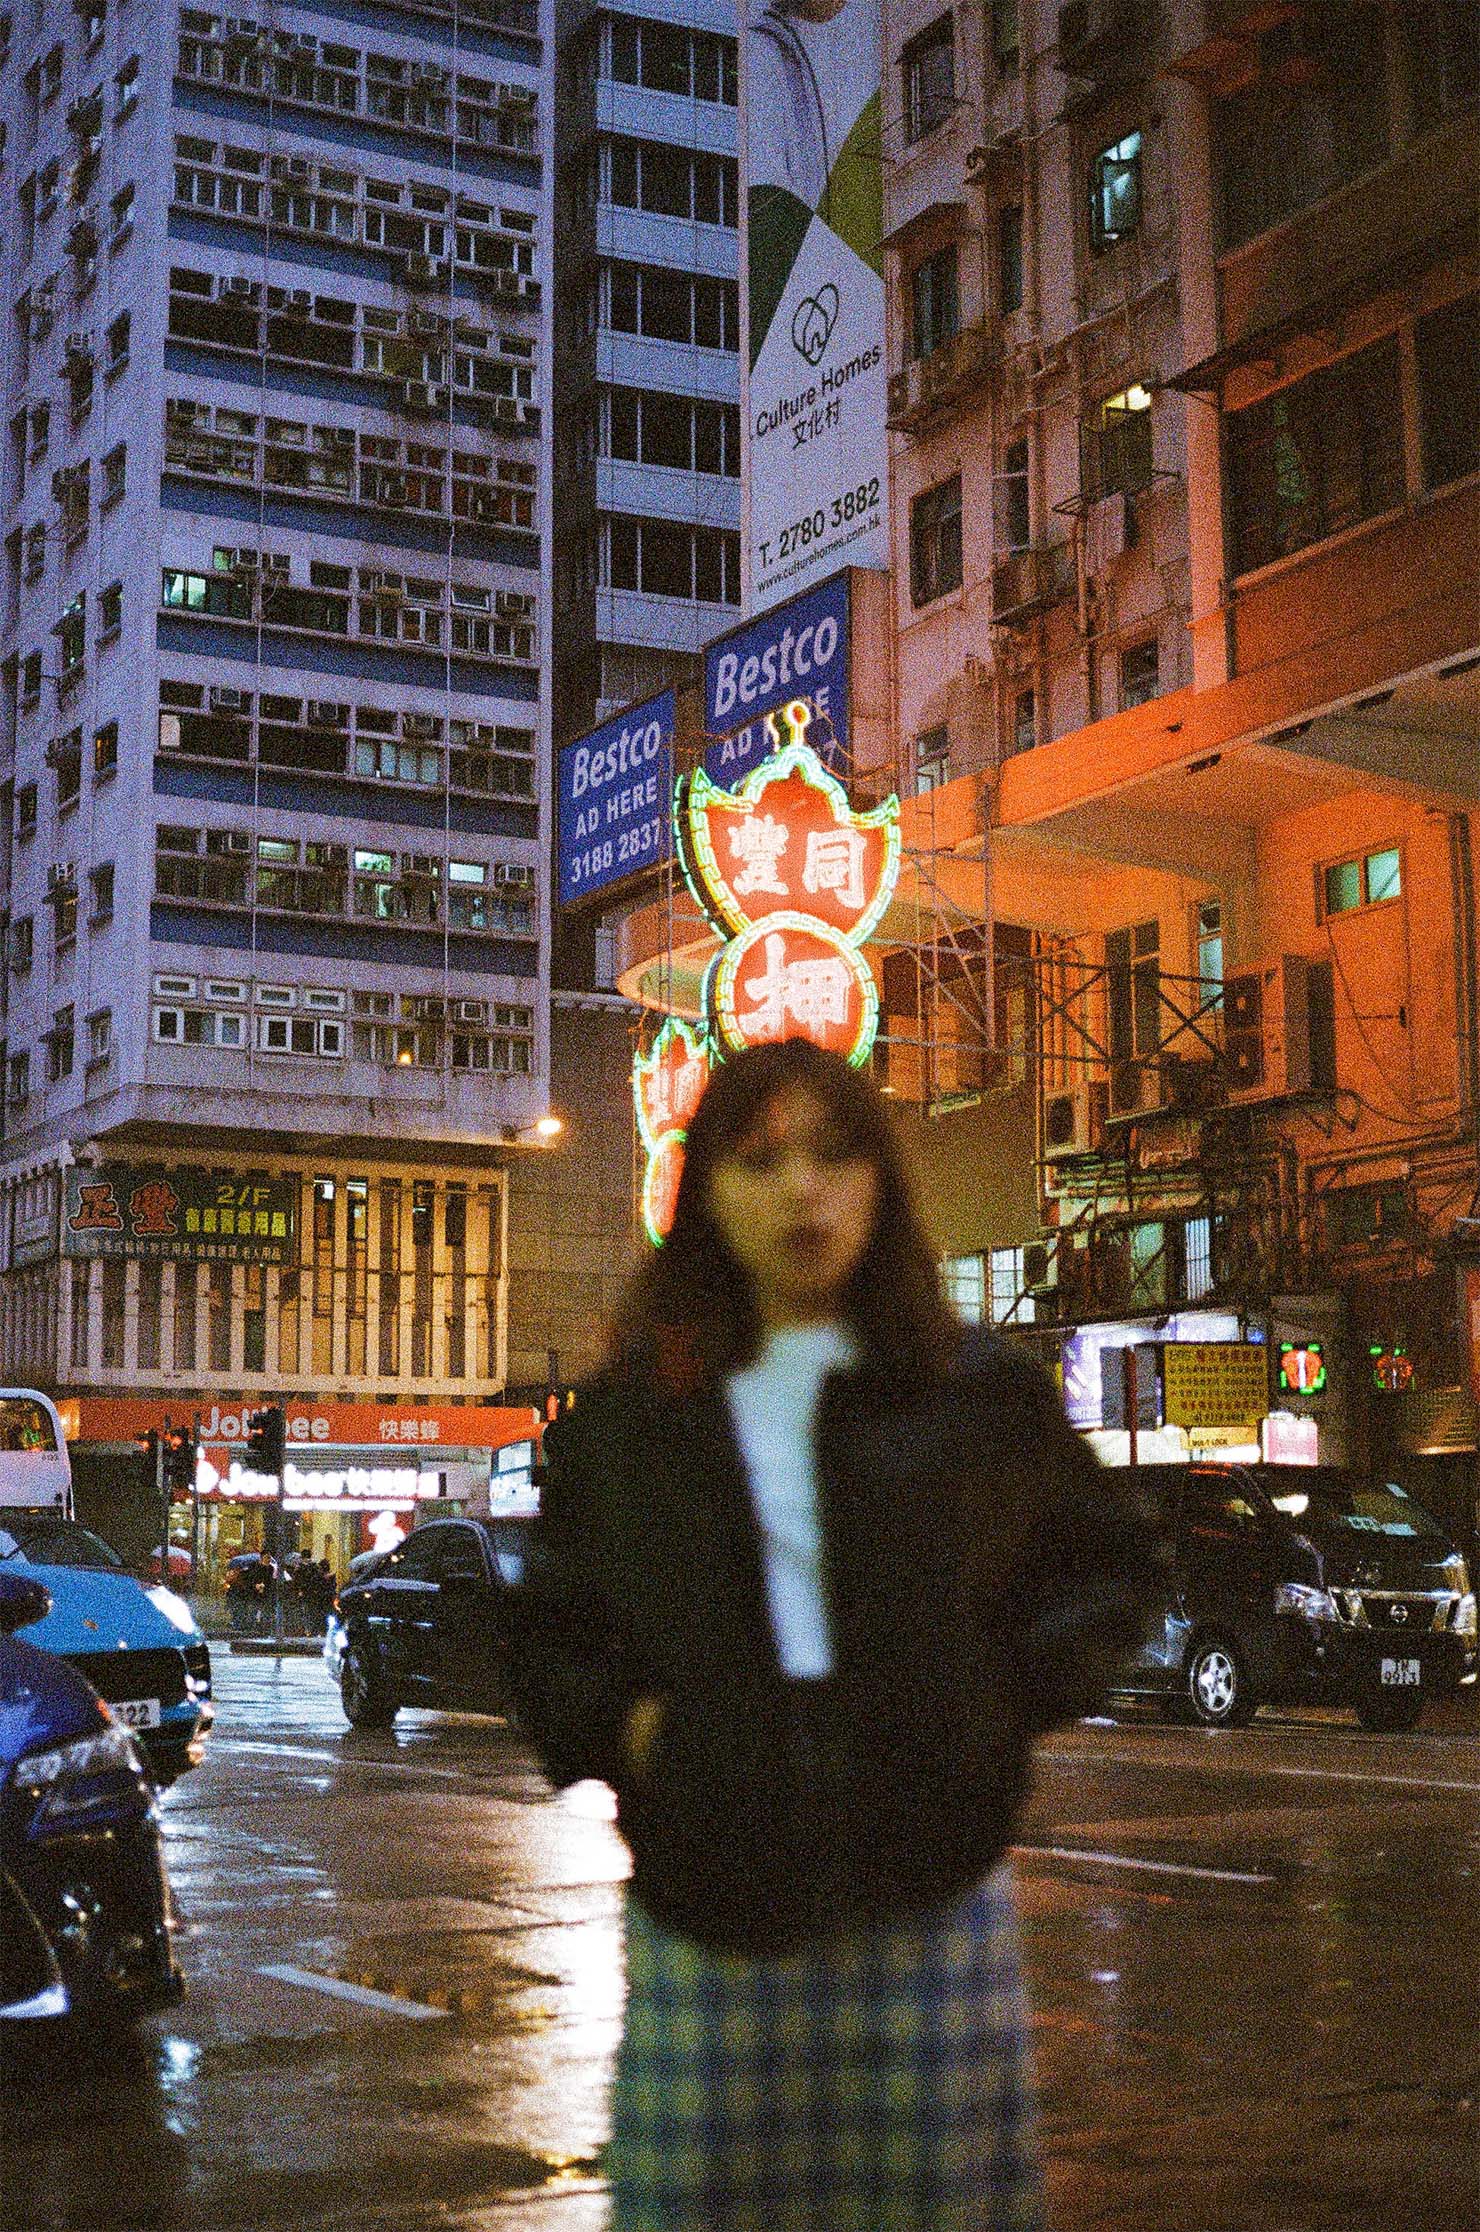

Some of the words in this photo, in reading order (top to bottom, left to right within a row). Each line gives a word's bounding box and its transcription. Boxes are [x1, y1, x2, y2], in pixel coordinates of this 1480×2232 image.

[757, 386, 817, 437] Culture
[821, 344, 880, 397] Homes
[792, 399, 841, 450] 文化村
[759, 541, 773, 569] T.
[779, 510, 825, 558] 2780
[831, 477, 880, 528] 3882
[714, 617, 838, 718] Bestco
[572, 720, 662, 798] Bestco
[720, 730, 751, 765] AD
[575, 807, 599, 840] AD
[606, 775, 658, 824] HERE
[571, 840, 613, 883] 3188
[618, 817, 662, 862] 2837
[217, 1185, 271, 1206] 2/F
